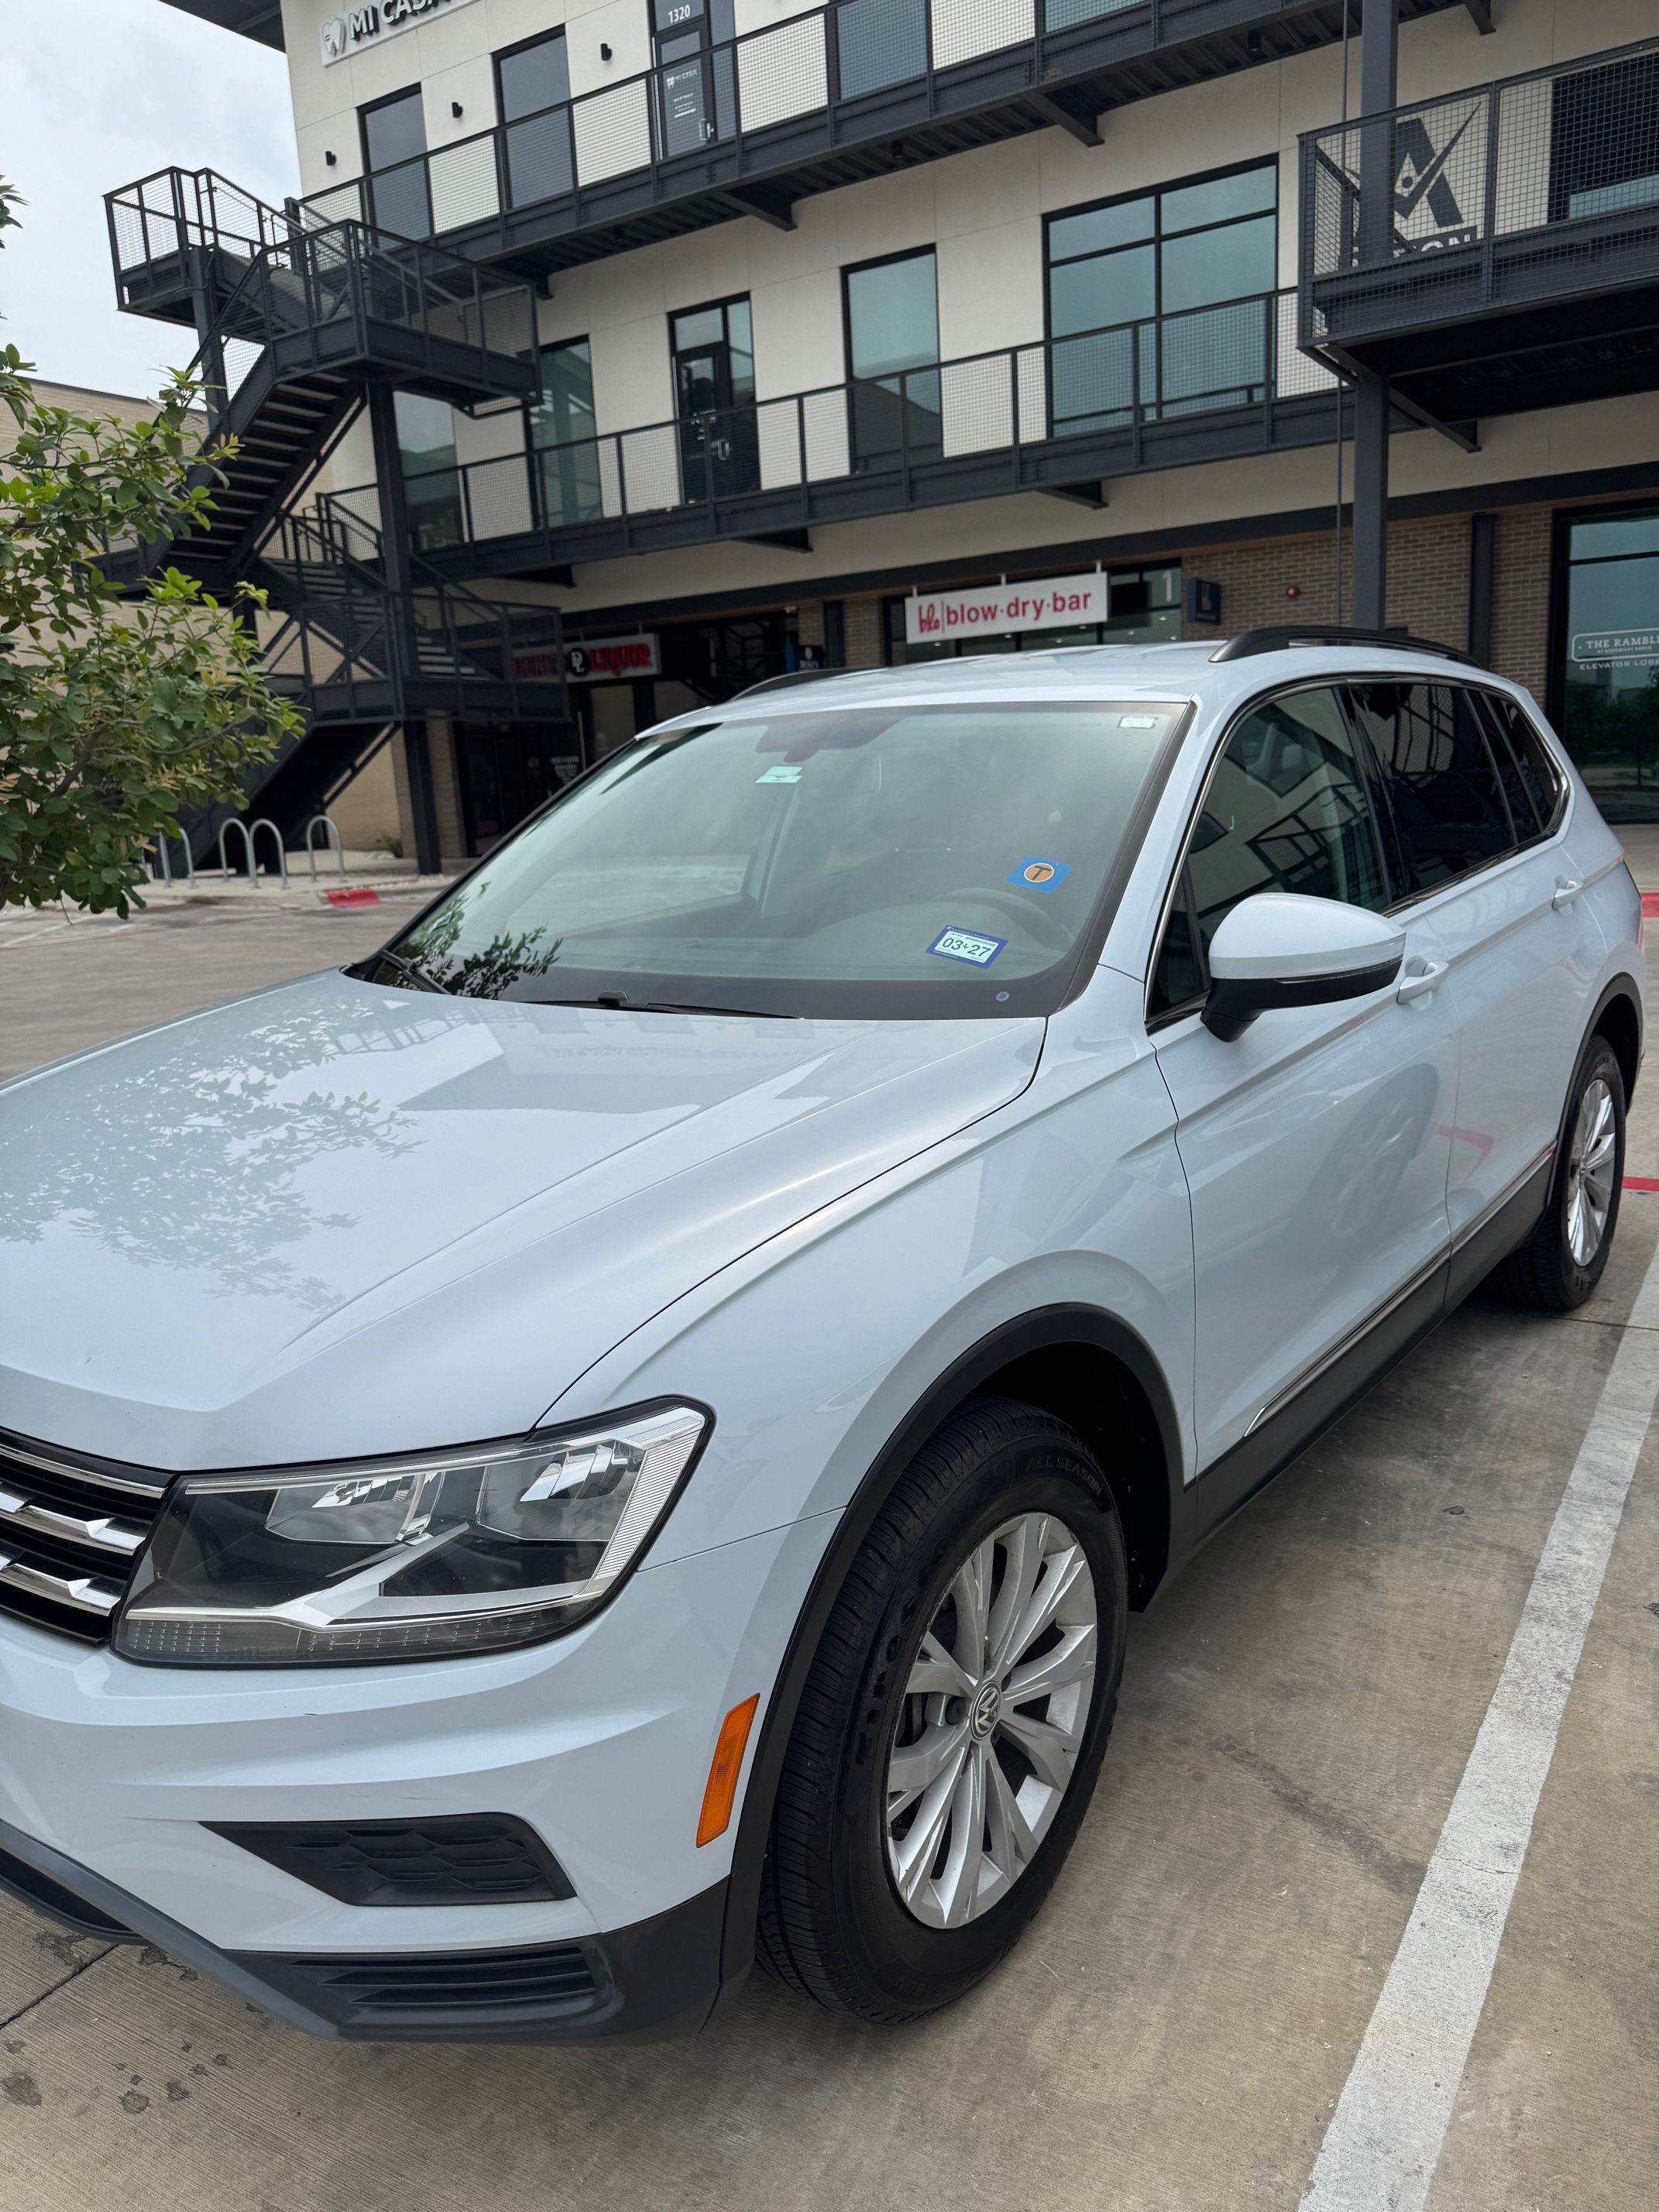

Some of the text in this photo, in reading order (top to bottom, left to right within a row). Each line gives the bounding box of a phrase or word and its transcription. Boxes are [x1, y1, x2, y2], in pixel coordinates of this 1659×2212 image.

[349, 5, 379, 40] MI
[668, 4, 691, 24] 1320
[1163, 570, 1173, 603] 1
[918, 604, 940, 634] blo
[1585, 639, 1610, 649] THE
[588, 644, 652, 677] LIQUOR
[1579, 661, 1630, 671] ELEVATOR
[1056, 1455, 1102, 1496] SEASON
